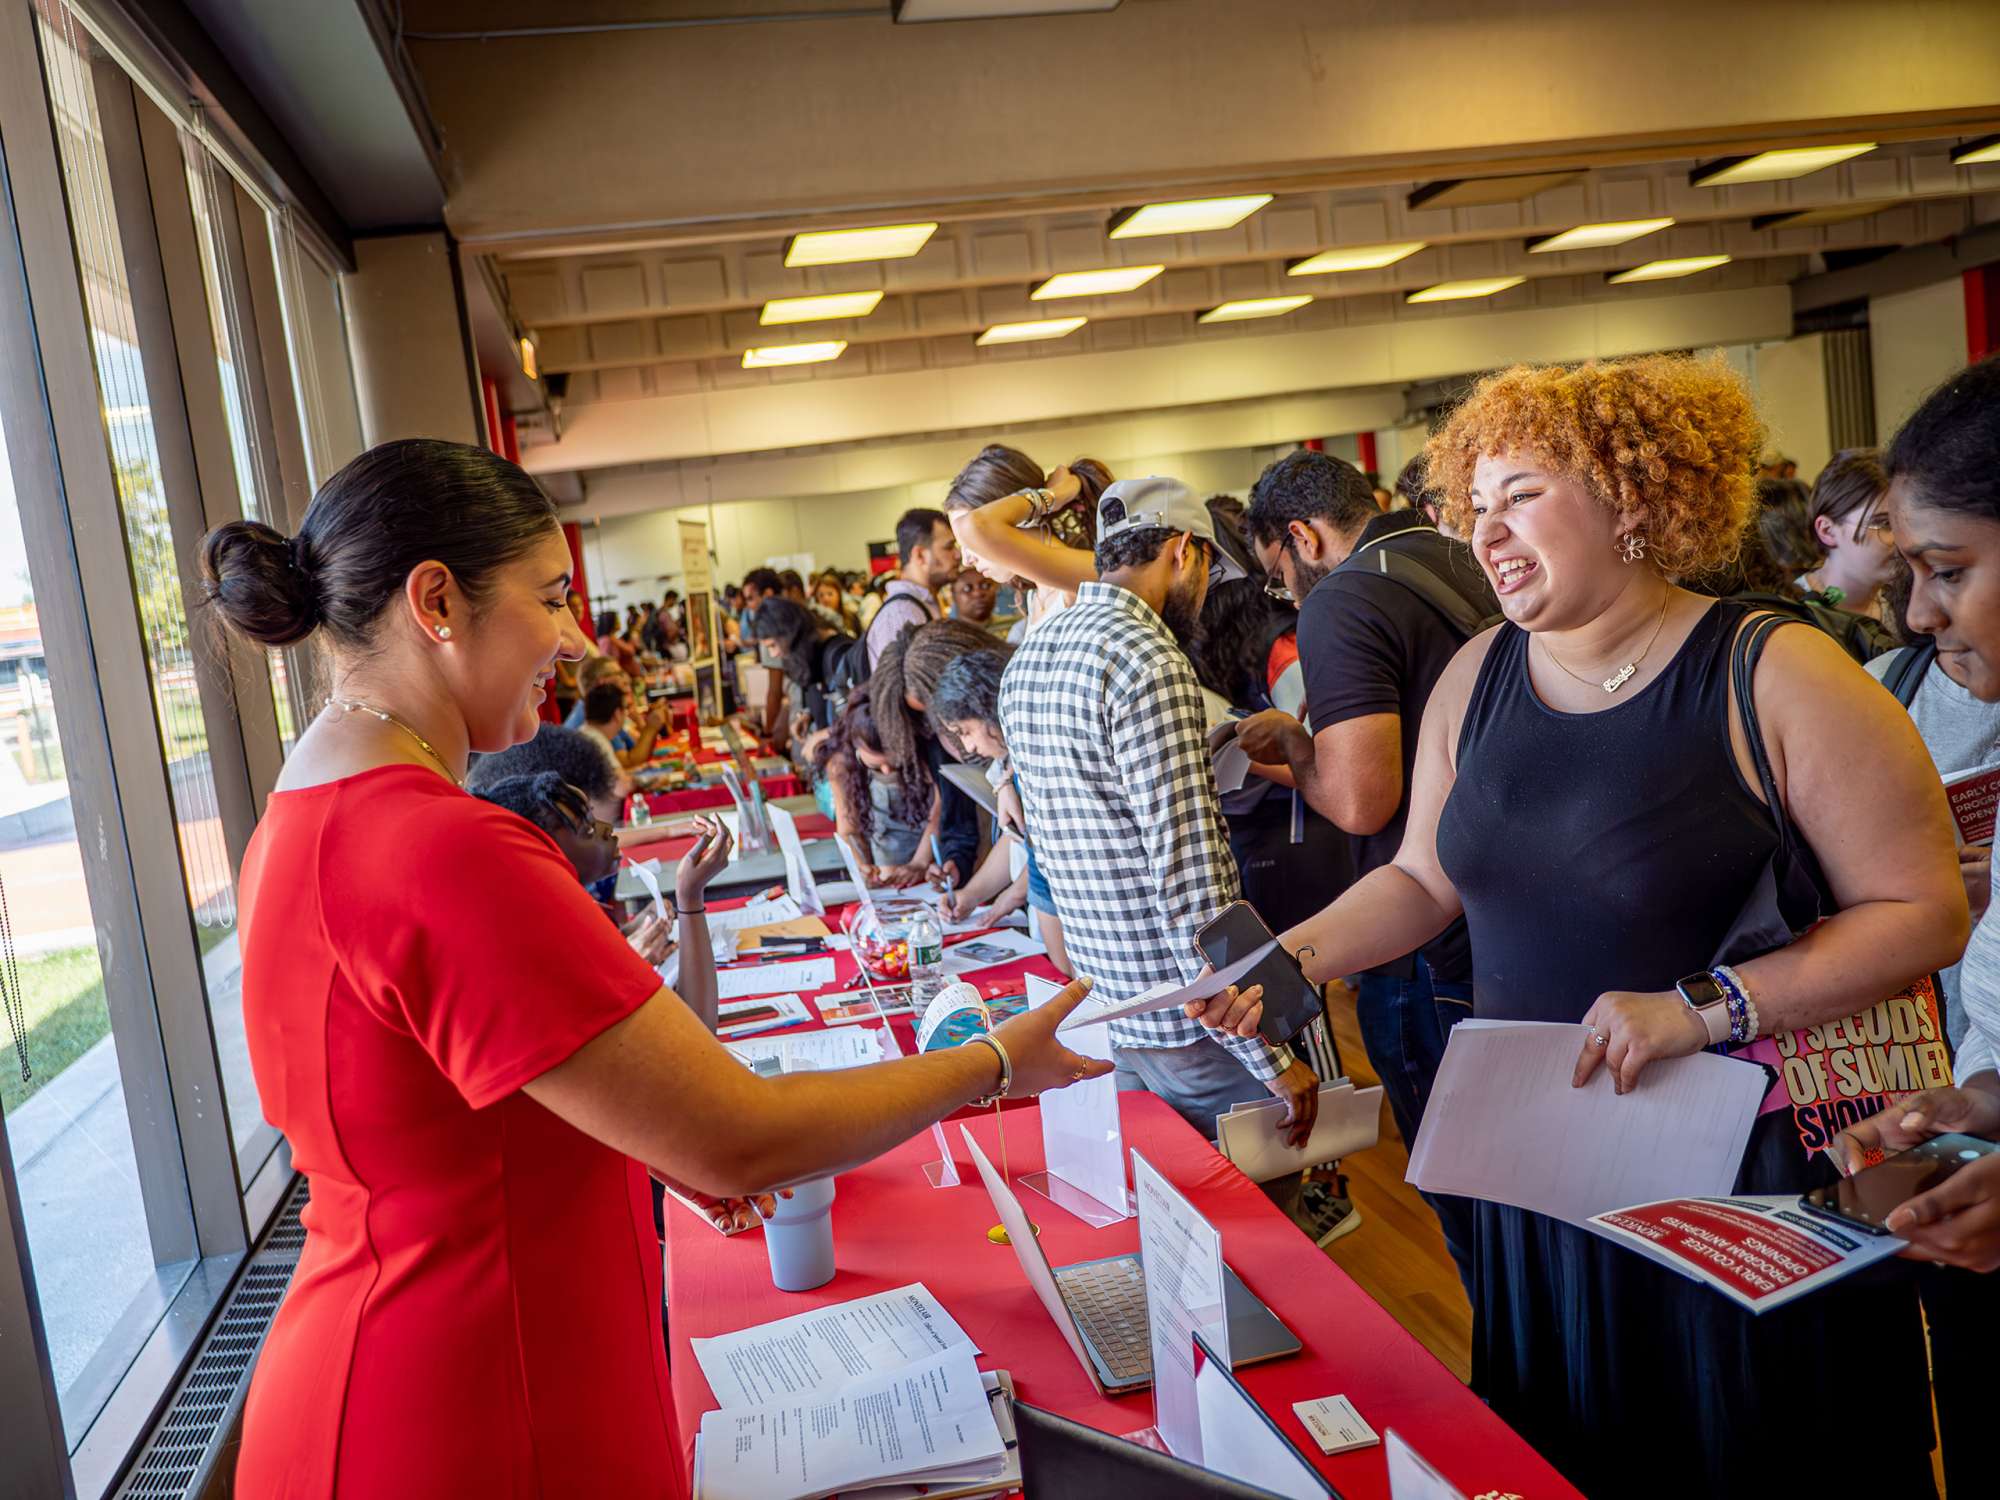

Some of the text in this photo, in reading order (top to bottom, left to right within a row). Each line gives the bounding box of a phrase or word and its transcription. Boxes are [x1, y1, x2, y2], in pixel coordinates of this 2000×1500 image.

[1952, 785, 1987, 803] EARLY
[1807, 995, 1936, 1051] SECODS
[1783, 1042, 1954, 1105] OF SUMER
[1661, 1216, 1731, 1248] ANTICIPATED
[1681, 1237, 1775, 1290] EARLY COLLEGE
[1727, 1244, 1792, 1283] PROGRAM
[1741, 1237, 1808, 1275] OPENINGS
